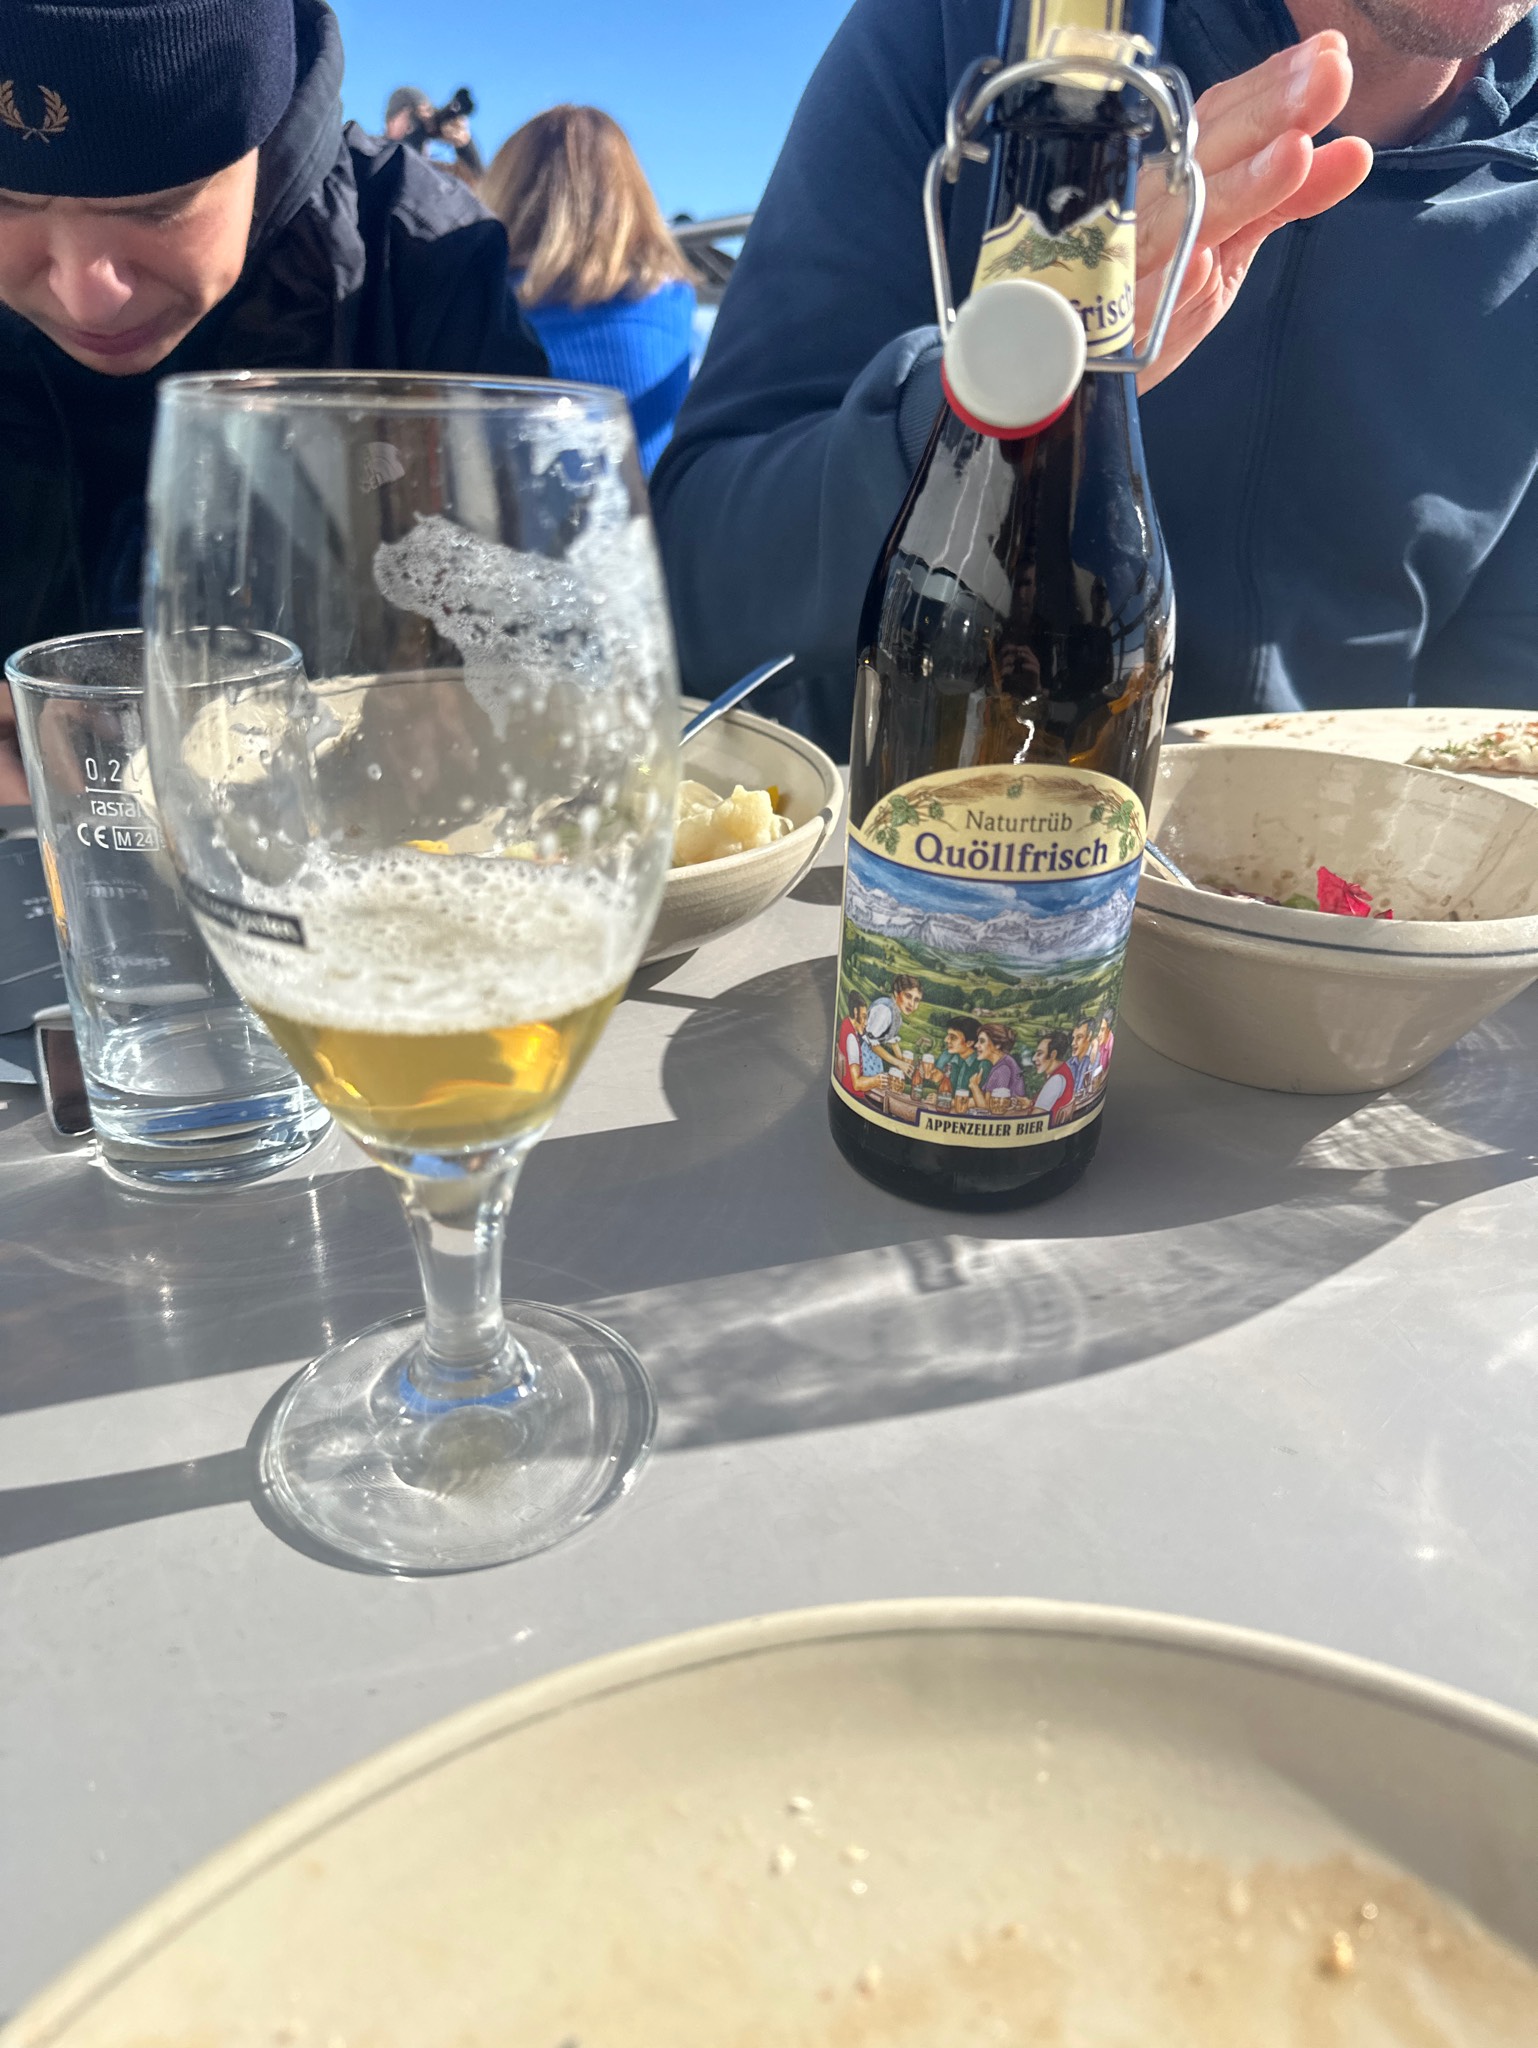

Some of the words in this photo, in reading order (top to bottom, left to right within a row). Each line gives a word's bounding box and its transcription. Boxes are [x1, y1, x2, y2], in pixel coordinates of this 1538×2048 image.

[90, 799, 141, 818] rastal
[966, 810, 1073, 833] Naturtrüb
[914, 831, 1108, 874] Quöllfrisch
[925, 1117, 1011, 1137] APPENZELLER
[1016, 1120, 1044, 1136] BIER
